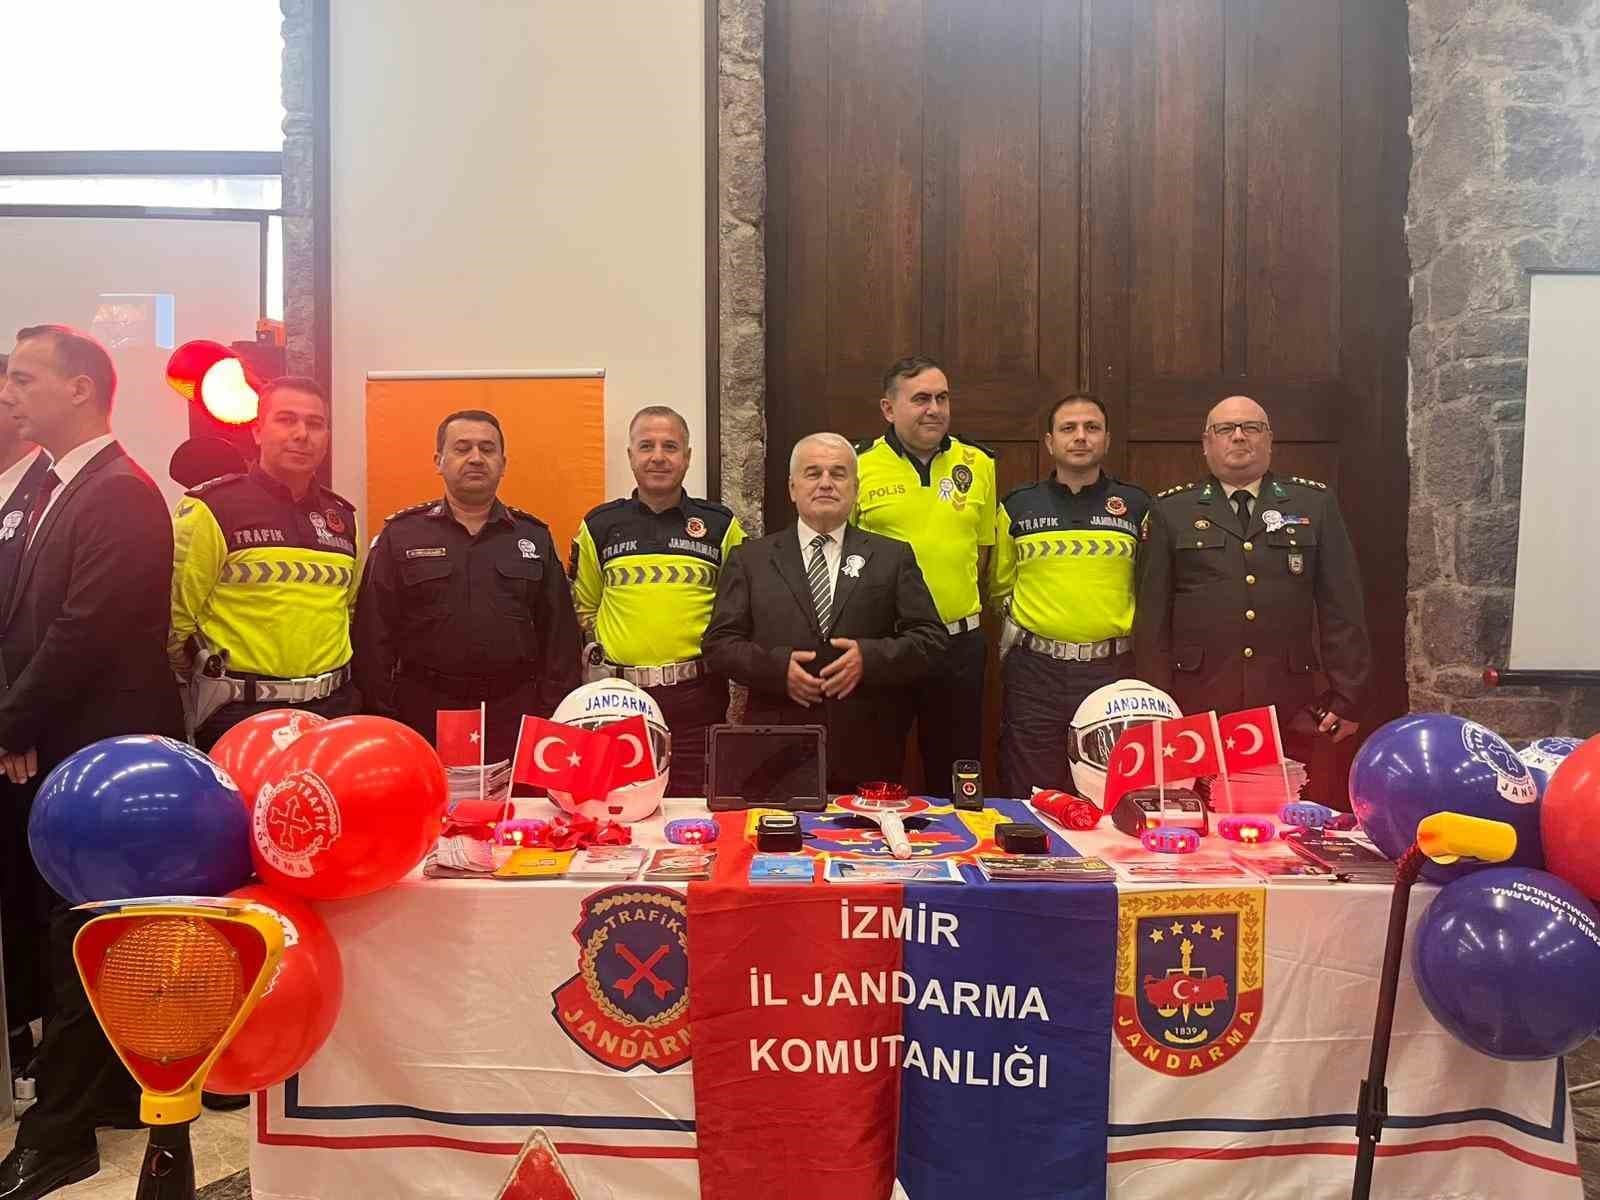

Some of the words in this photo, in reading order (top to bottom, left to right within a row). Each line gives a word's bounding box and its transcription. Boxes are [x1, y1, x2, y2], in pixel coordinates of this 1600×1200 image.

[585, 694, 654, 718] JANDARMA
[1105, 697, 1174, 716] JANDARMA
[841, 899, 960, 948] İZMİR
[749, 967, 788, 1007] İL
[801, 970, 1050, 1022] JANDARMA
[1118, 1011, 1255, 1069] JANDARMA
[1175, 1027, 1197, 1035] 1839
[749, 1034, 1049, 1089] KOMUTANLIĞI
